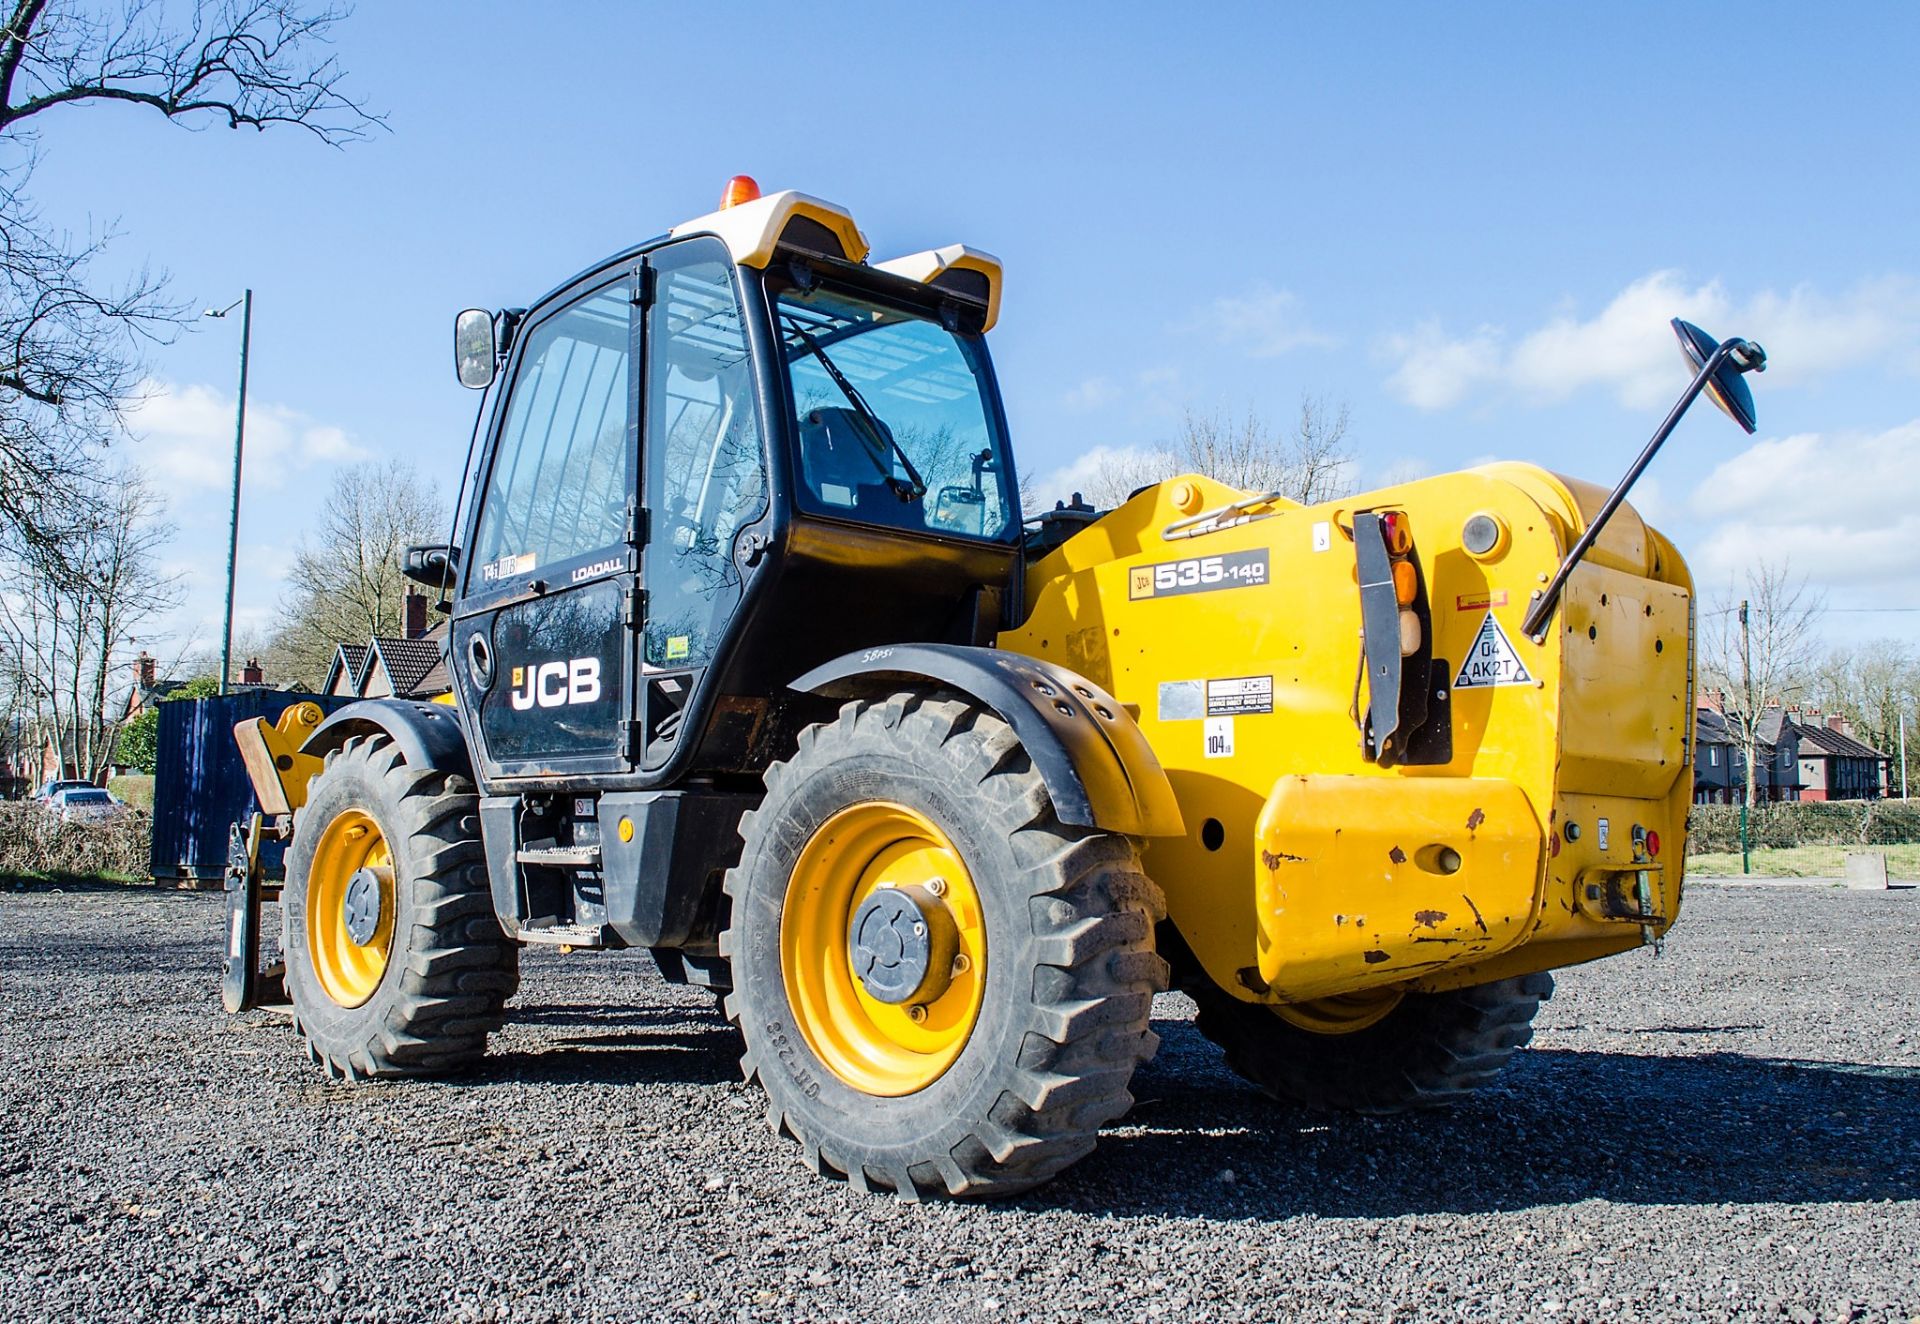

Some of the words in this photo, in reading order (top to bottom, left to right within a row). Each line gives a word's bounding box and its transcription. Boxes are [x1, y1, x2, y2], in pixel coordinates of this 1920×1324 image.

[572, 558, 624, 582] LOADALL
[1482, 642, 1499, 656] 04
[1472, 660, 1511, 677] AK2T
[512, 657, 600, 710] JCB
[1208, 735, 1224, 753] 104
